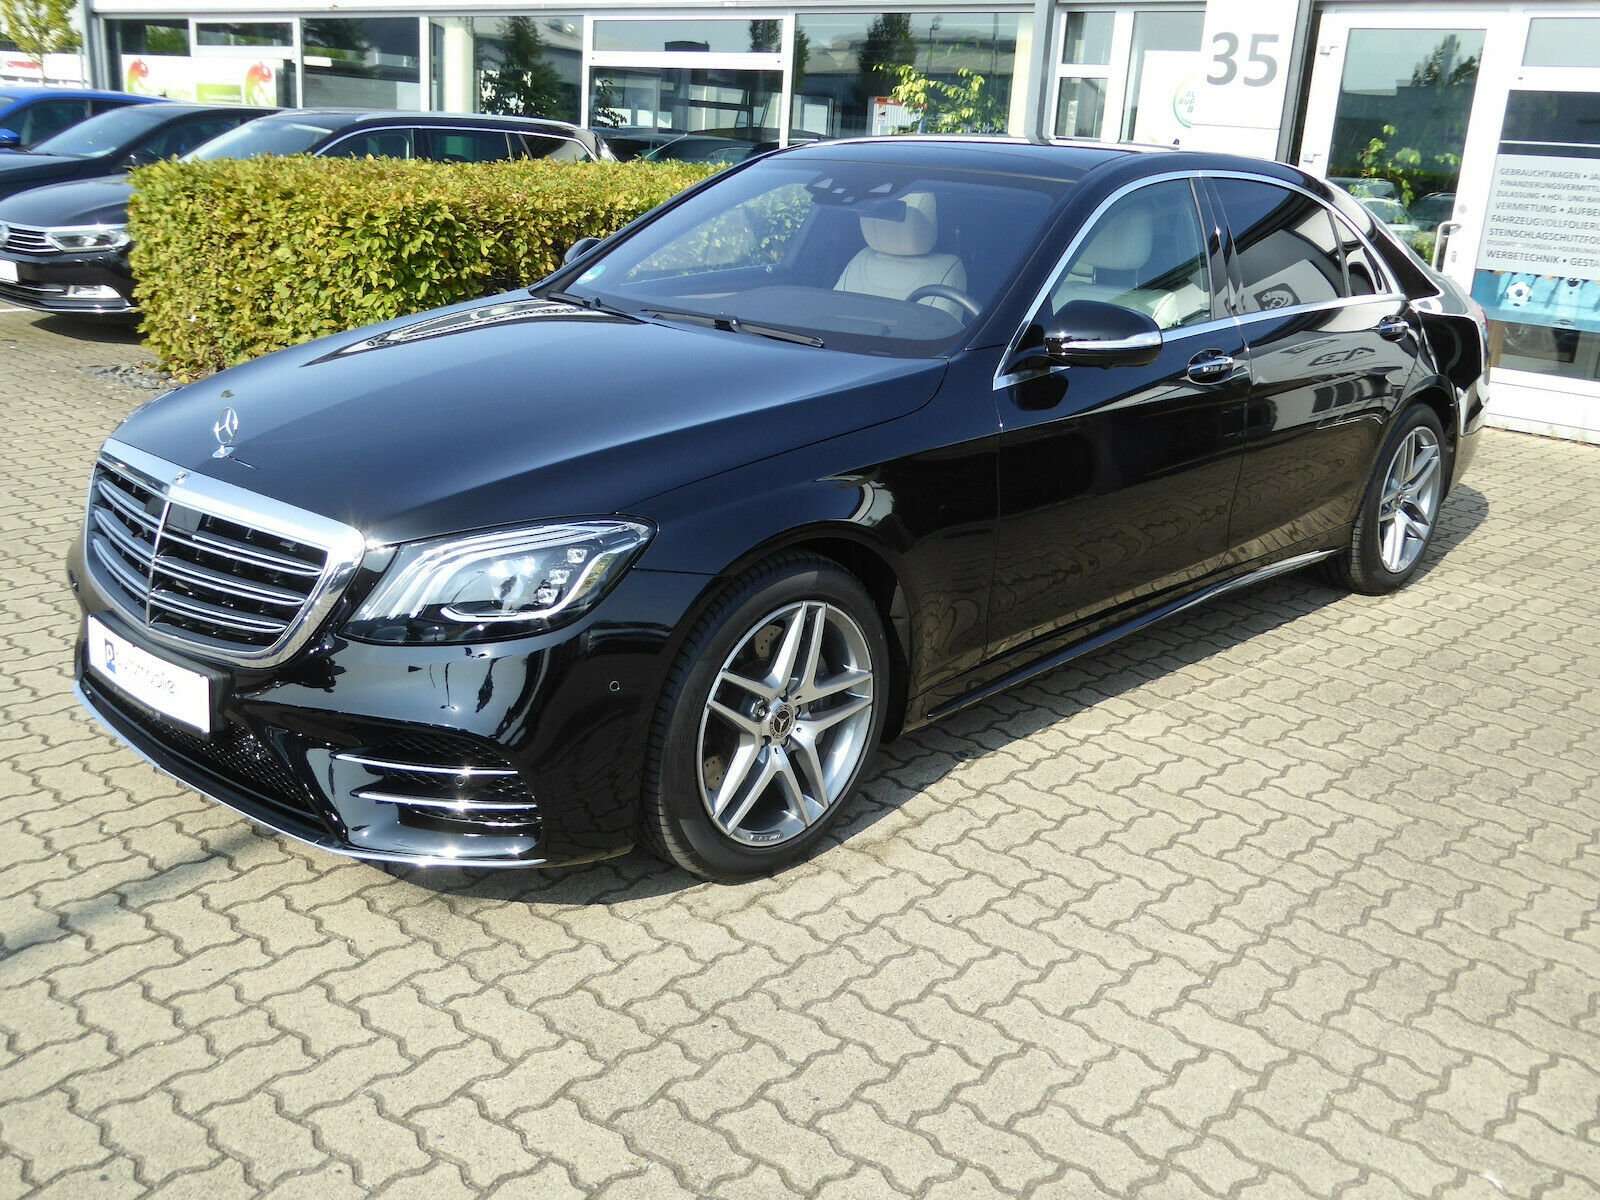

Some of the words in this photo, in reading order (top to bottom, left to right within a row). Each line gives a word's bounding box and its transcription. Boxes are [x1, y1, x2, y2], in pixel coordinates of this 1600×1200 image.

[1206, 32, 1280, 87] 35
[1499, 168, 1581, 180] GEBRAUCHTWAGEN
[1495, 201, 1557, 214] VERMIETUNG
[1567, 206, 1600, 217] AUFBE
[1487, 249, 1560, 264] WERBETECHNIK
